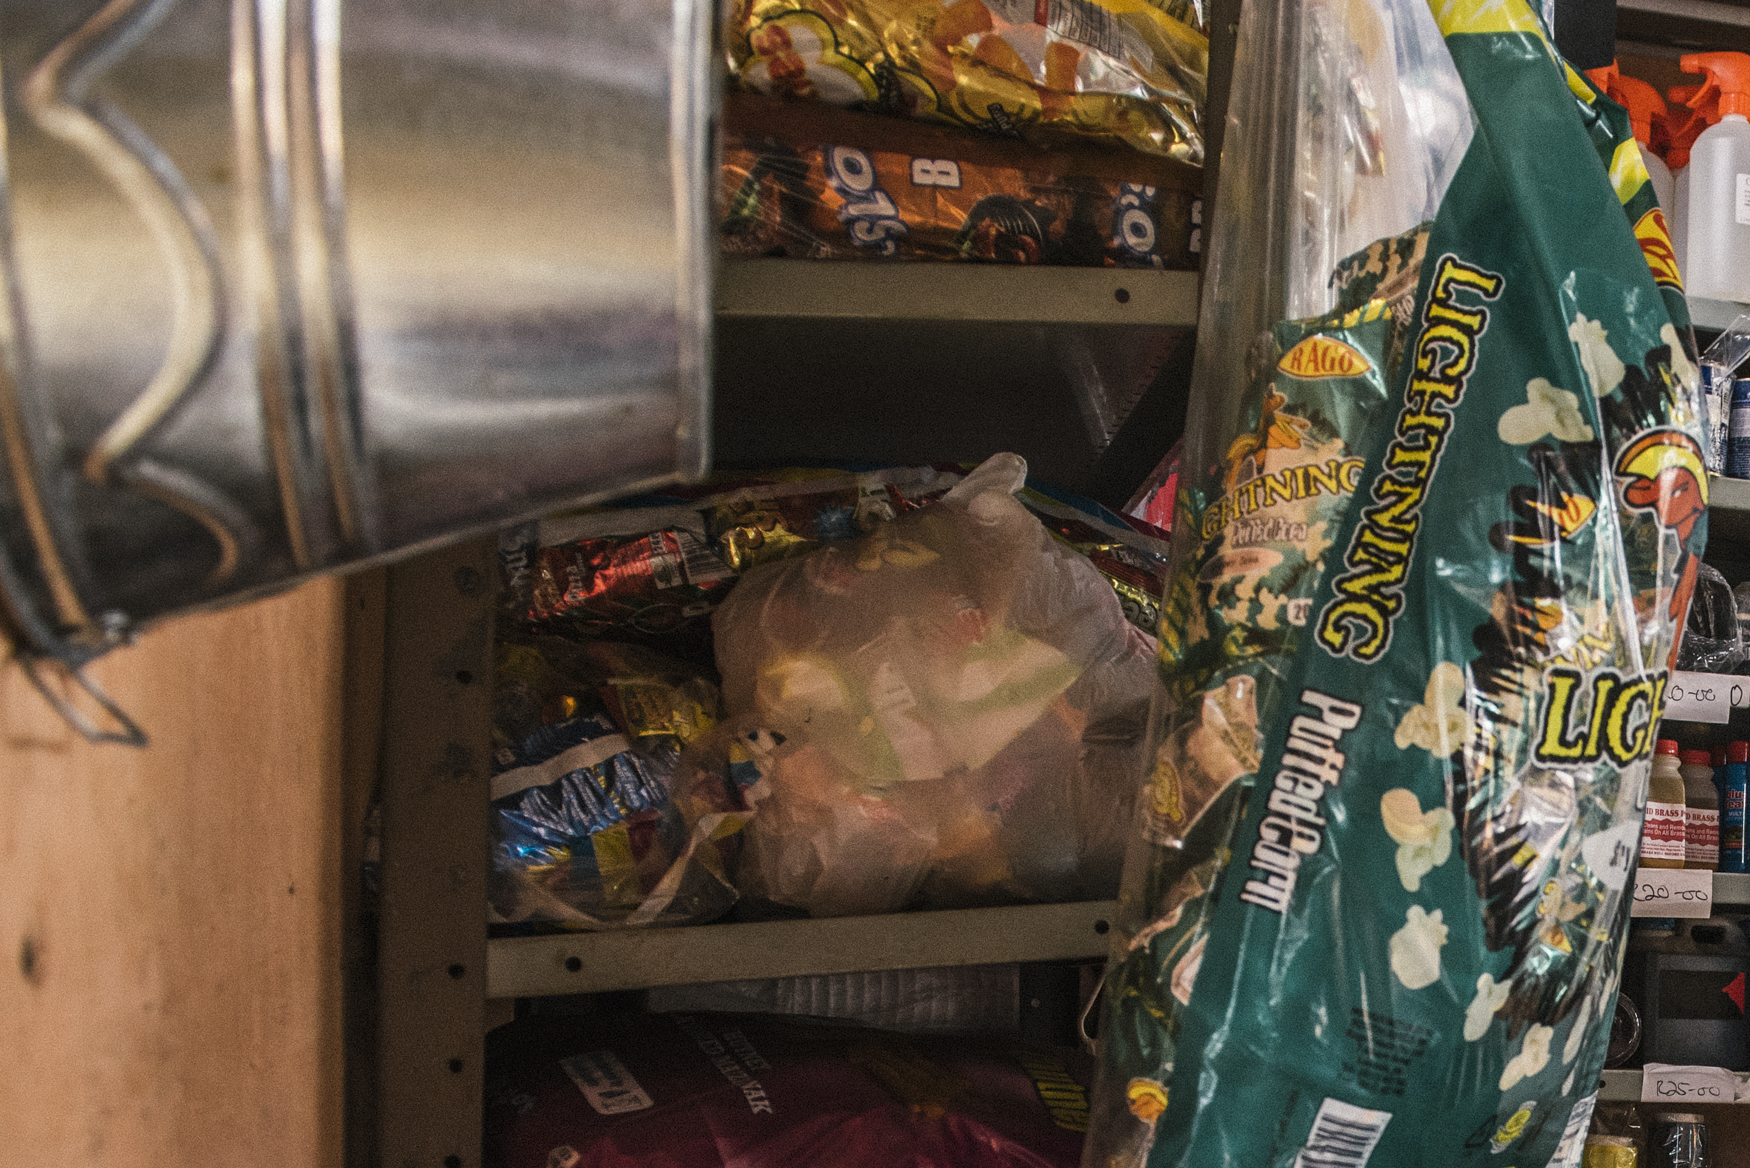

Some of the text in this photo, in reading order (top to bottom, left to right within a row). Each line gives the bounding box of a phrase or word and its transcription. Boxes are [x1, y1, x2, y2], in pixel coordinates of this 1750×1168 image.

[1316, 253, 1504, 665] LIGHTNING
[1655, 809, 1679, 817] BRASS
[1692, 813, 1715, 822] BRASS
